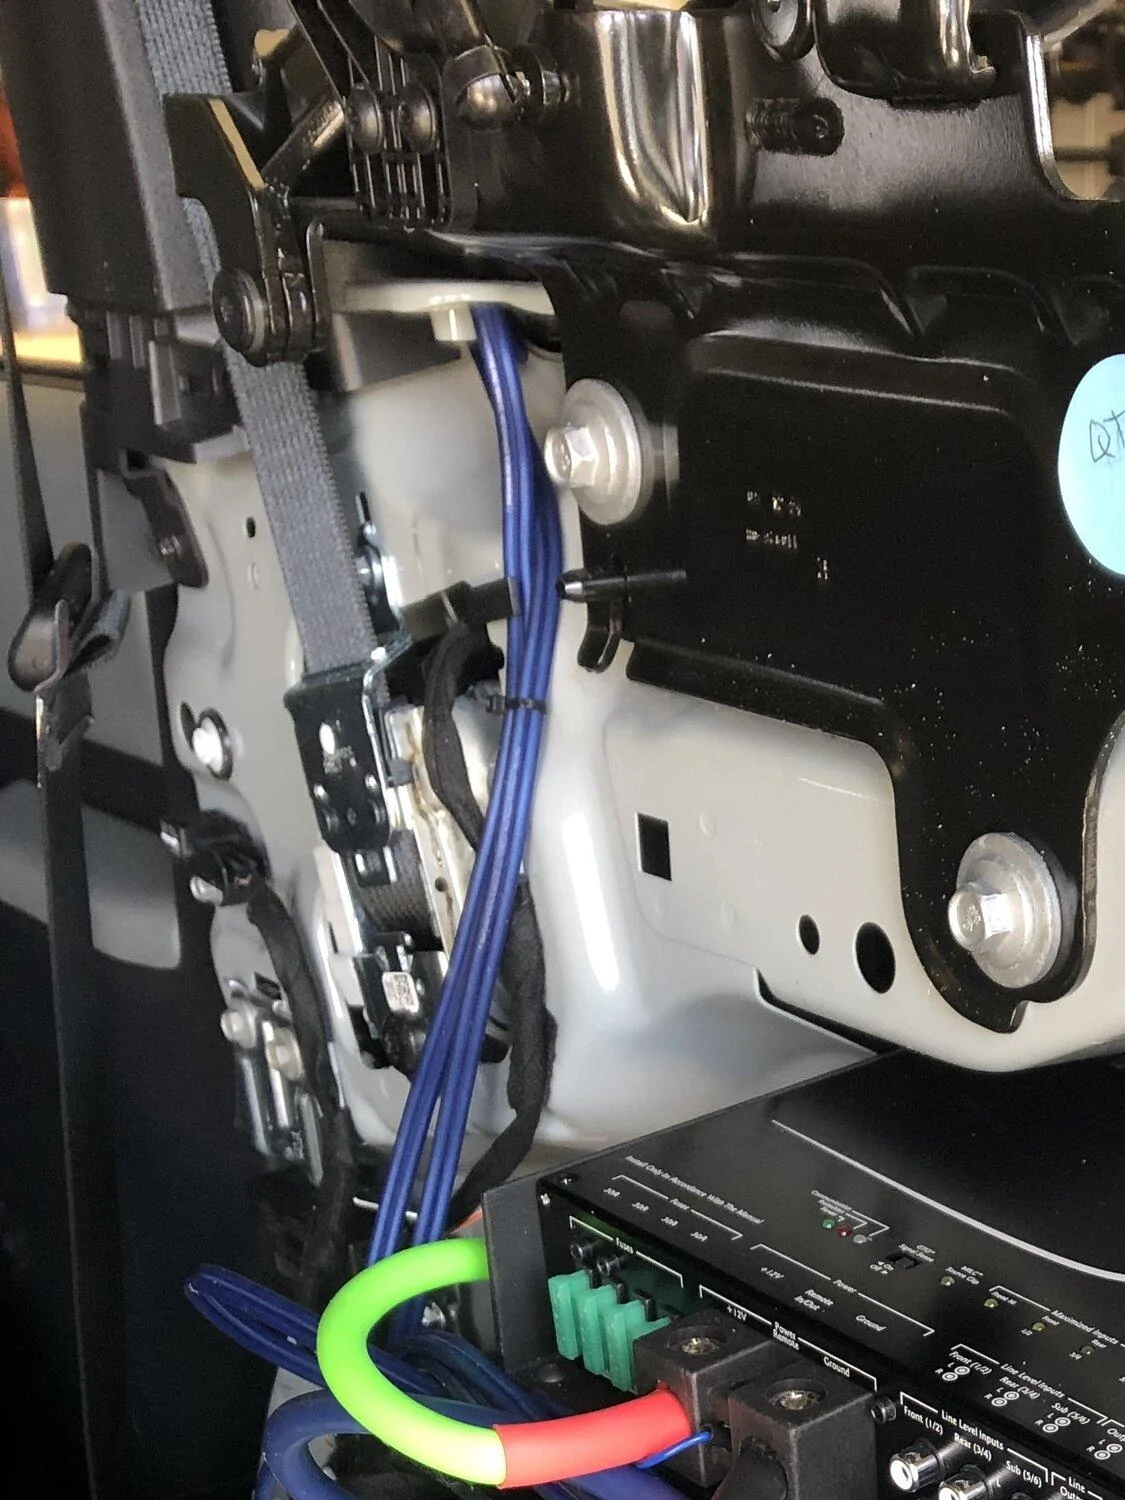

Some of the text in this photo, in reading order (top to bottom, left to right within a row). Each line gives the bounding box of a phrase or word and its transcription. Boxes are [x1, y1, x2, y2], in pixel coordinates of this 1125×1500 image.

[832, 1278, 857, 1294] Power
[804, 1288, 834, 1306] Remote
[726, 1304, 748, 1322] +12V
[855, 1314, 887, 1333] Ground
[774, 1321, 797, 1341] Power
[1051, 1309, 1119, 1345] Maximized Inputs
[772, 1330, 800, 1351] Remote
[823, 1356, 851, 1378] Ground
[949, 1351, 992, 1375] Front (1/2)
[1000, 1376, 1020, 1389] Rear
[1001, 1363, 1065, 1398] Line Level Inputs
[1051, 1402, 1069, 1414] Sub
[903, 1405, 944, 1436] Front (1/2)
[941, 1408, 1005, 1451] Line Level Inputs
[953, 1432, 992, 1462] Rear (3/4)
[1005, 1460, 1042, 1489] Sub (5/6)
[1068, 1475, 1086, 1494] Line
